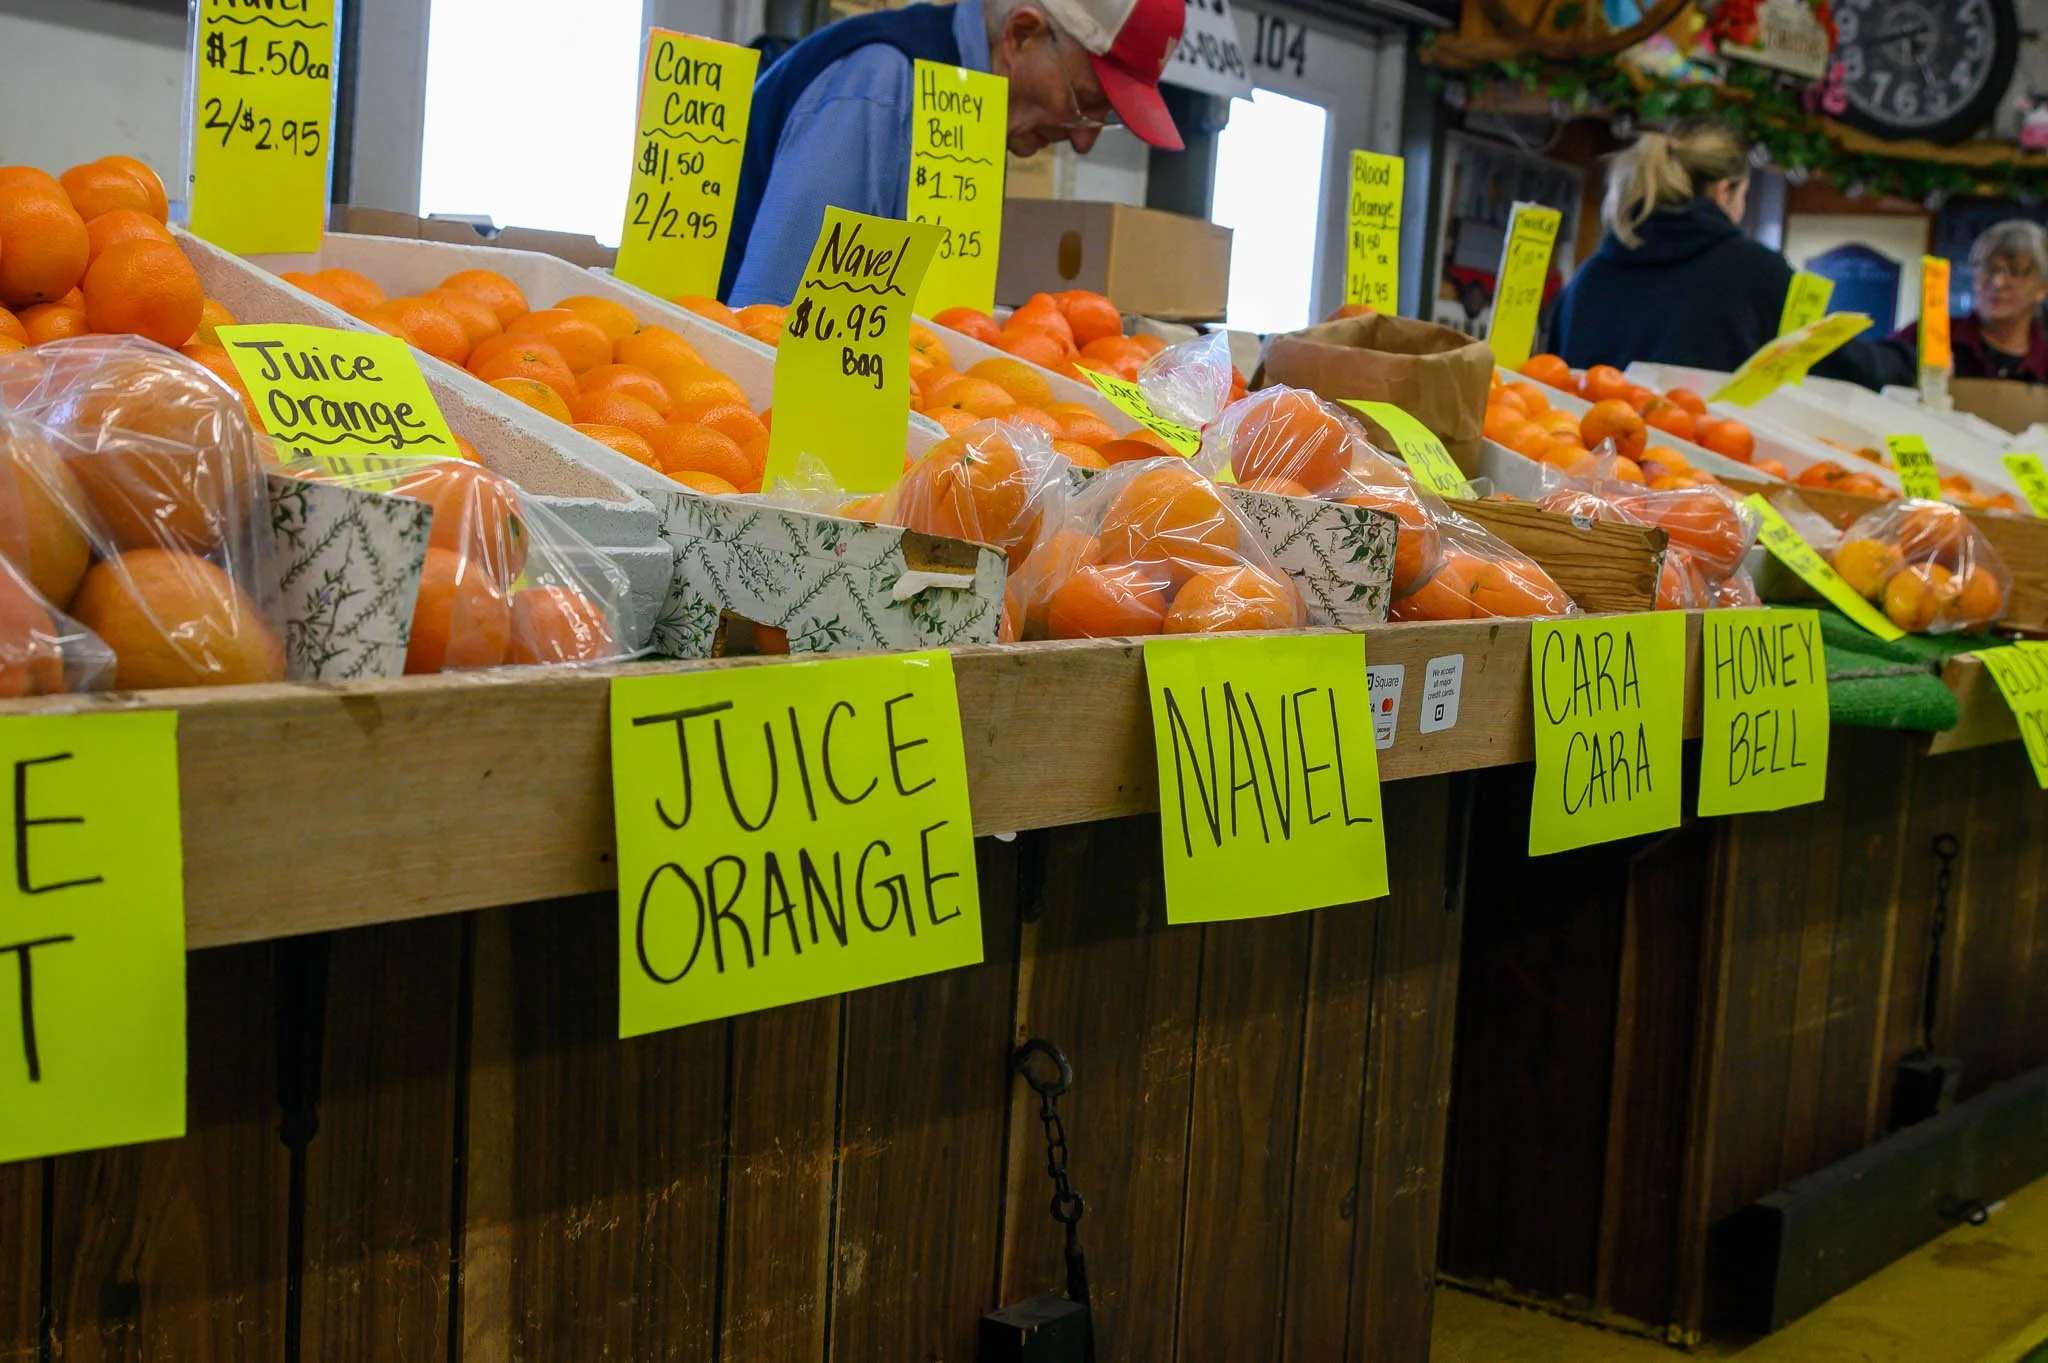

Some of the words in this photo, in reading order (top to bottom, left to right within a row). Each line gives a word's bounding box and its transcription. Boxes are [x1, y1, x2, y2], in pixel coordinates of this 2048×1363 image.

[654, 41, 723, 92] Cara
[663, 92, 726, 132] Cara
[921, 68, 984, 123] Honey
[204, 97, 321, 157] 2/$2.95
[927, 118, 964, 151] Bell
[638, 140, 704, 185] $1.50
[701, 179, 721, 197] ea
[915, 165, 978, 202] $1.75
[632, 191, 718, 242] 2/2.95
[817, 221, 911, 287] Navel
[788, 297, 888, 342] $6.95
[232, 340, 384, 382] Juice
[842, 346, 884, 390] Bag
[268, 388, 427, 450] Orange
[1374, 675, 1400, 689] Square
[1541, 629, 1641, 725] CARA
[1714, 620, 1815, 701] HONEY
[632, 692, 937, 832] JUICE
[1163, 681, 1373, 858] NAVEL
[1563, 721, 1653, 815] CARA
[1729, 709, 1808, 787] BELL
[635, 820, 963, 985] ORANGE
